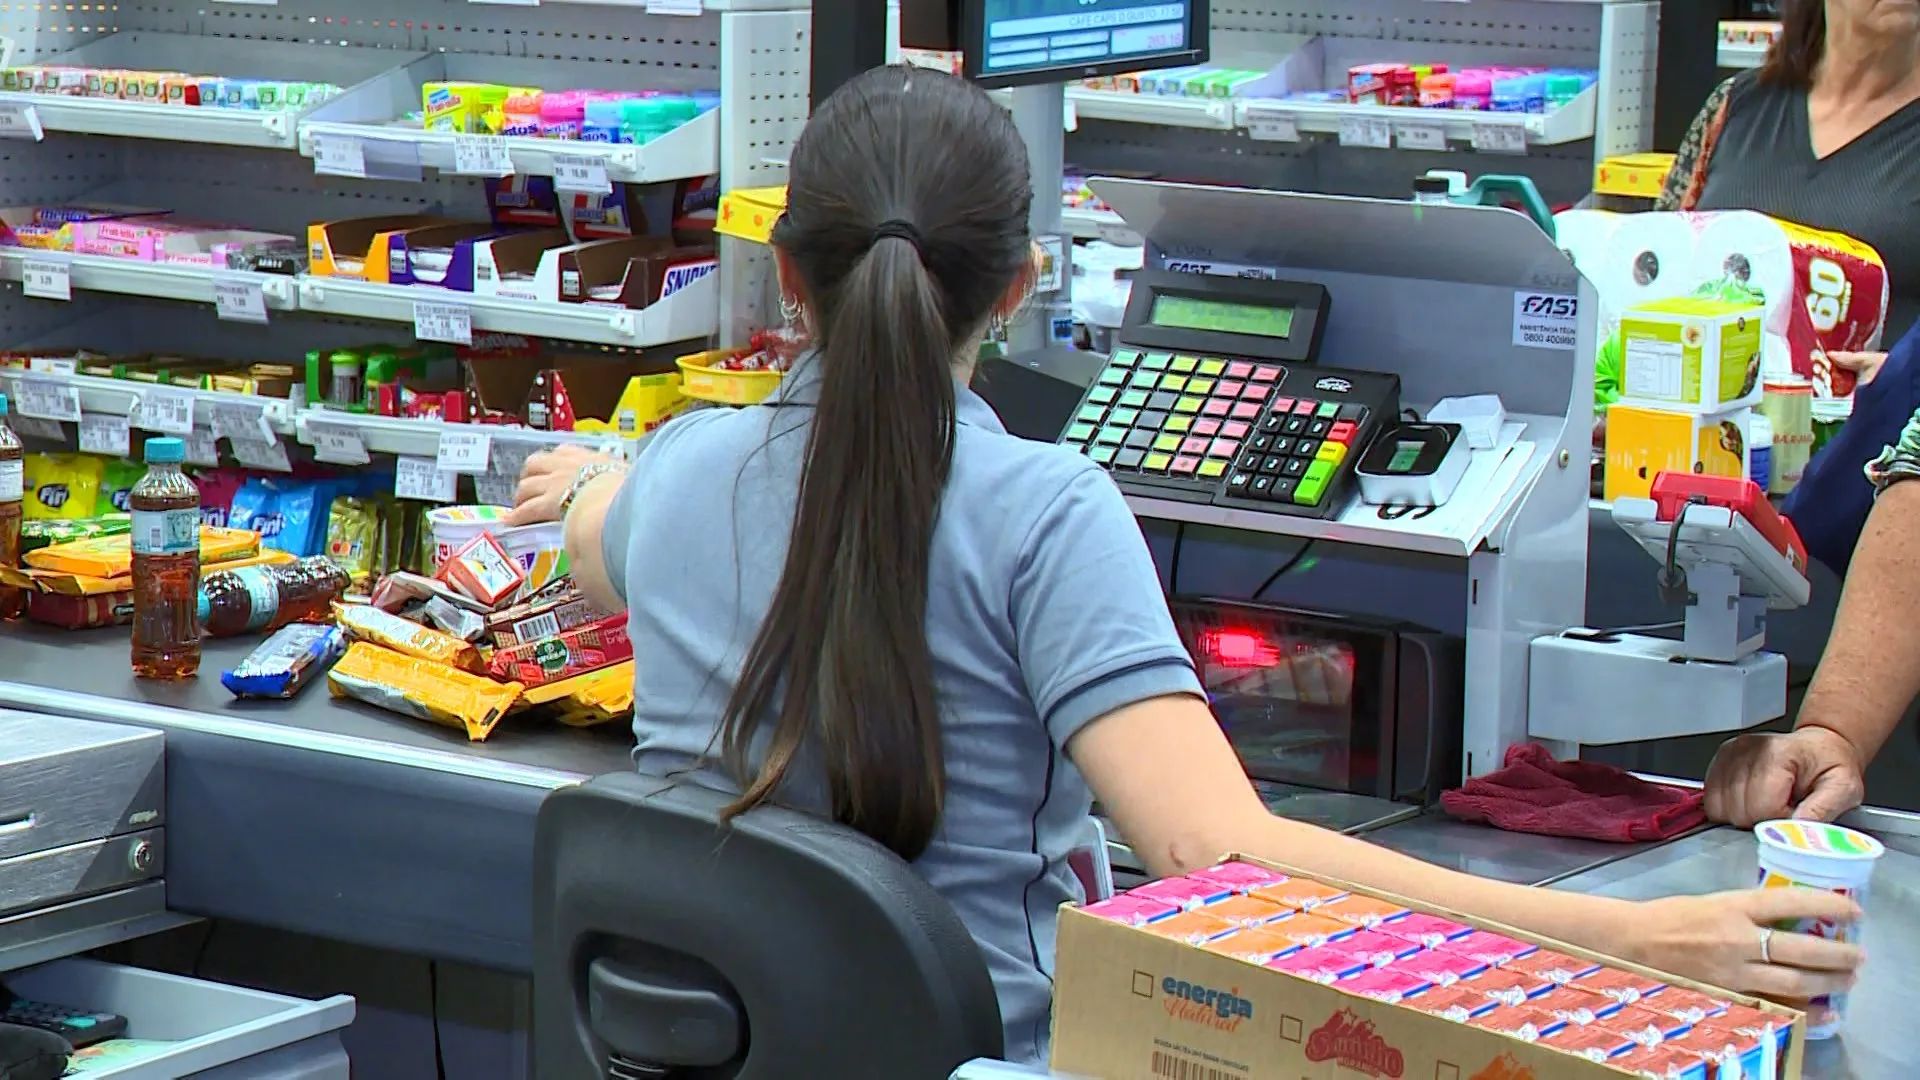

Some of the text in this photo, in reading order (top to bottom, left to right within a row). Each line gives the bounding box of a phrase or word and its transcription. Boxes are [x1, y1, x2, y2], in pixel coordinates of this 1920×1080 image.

[1806, 257, 1846, 332] 60
[253, 513, 283, 536] Fini
[1162, 976, 1254, 1020] energia
[1163, 998, 1245, 1033] Natural
